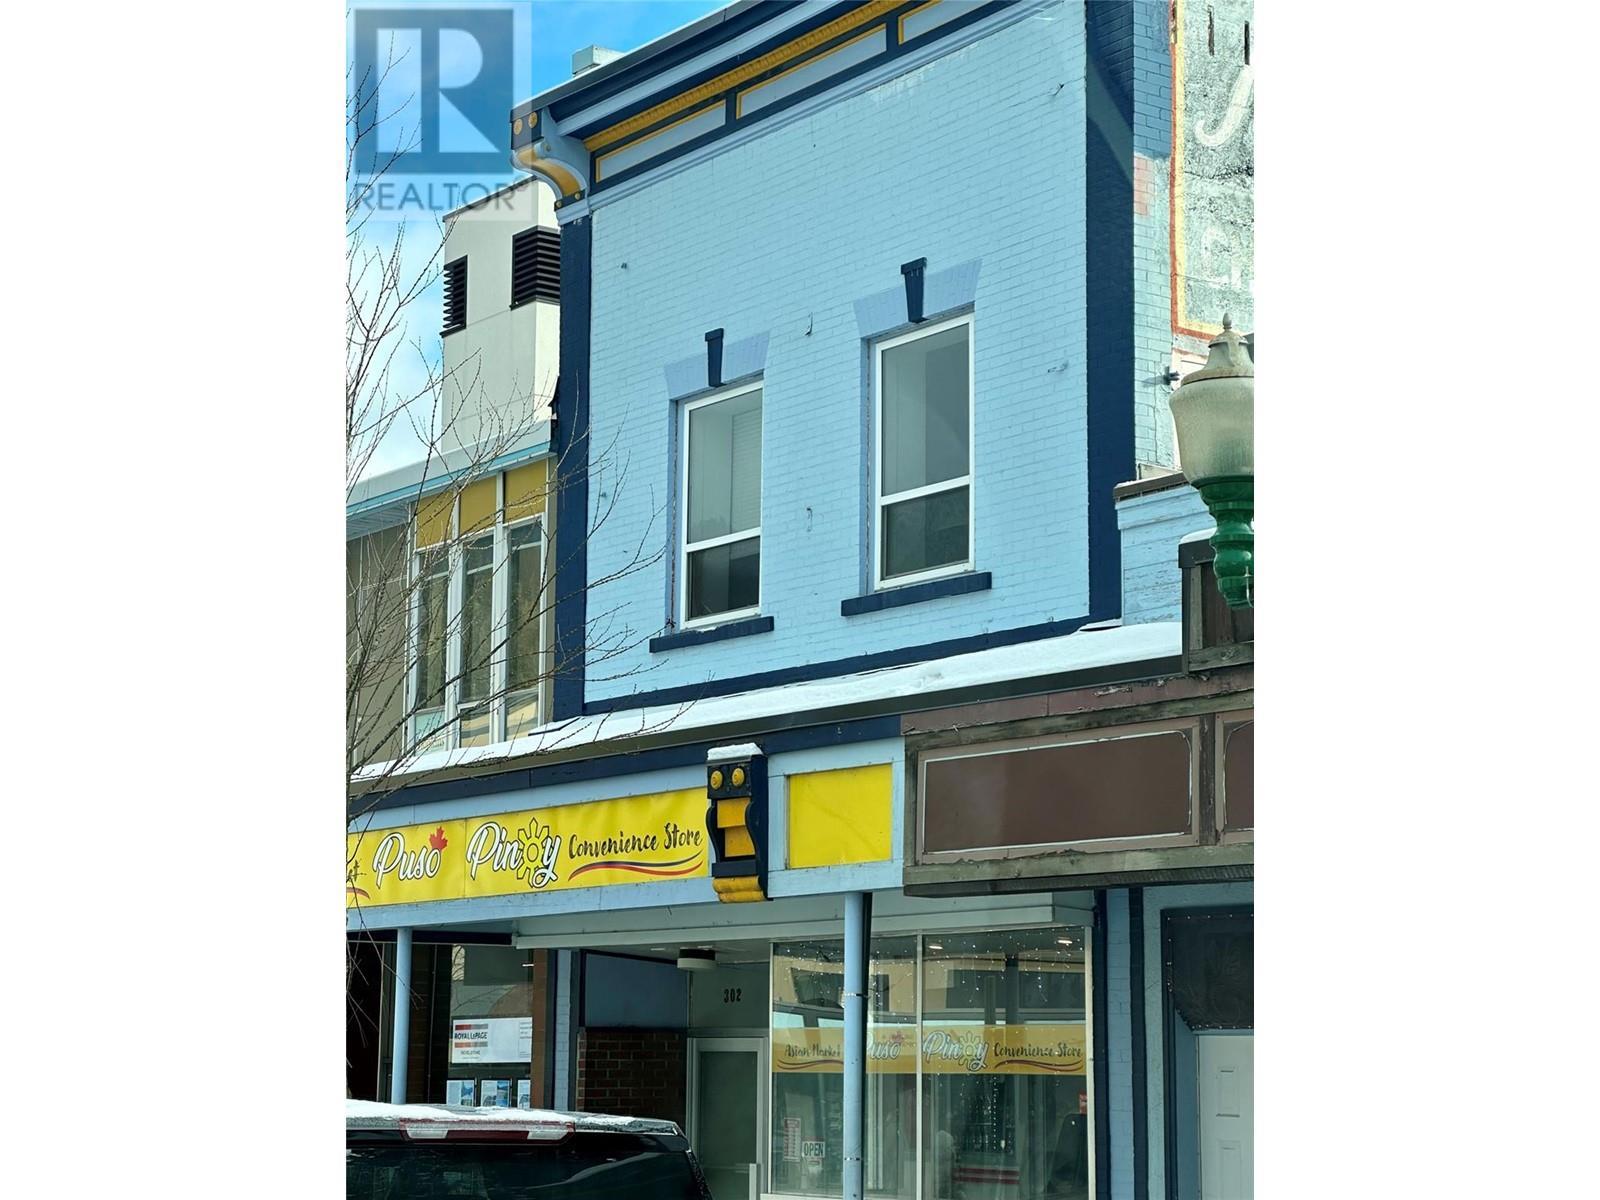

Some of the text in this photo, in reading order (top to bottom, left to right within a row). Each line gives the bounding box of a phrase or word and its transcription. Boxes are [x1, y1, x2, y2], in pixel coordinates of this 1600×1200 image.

[372, 832, 442, 890] Puso
[466, 817, 562, 889] Pinoy
[568, 831, 659, 860] Convenience
[663, 822, 703, 850] Store
[723, 988, 742, 1003] 302
[922, 1030, 989, 1073] Pinoy
[1056, 1040, 1084, 1057] Store
[803, 1142, 824, 1157] OPEN
